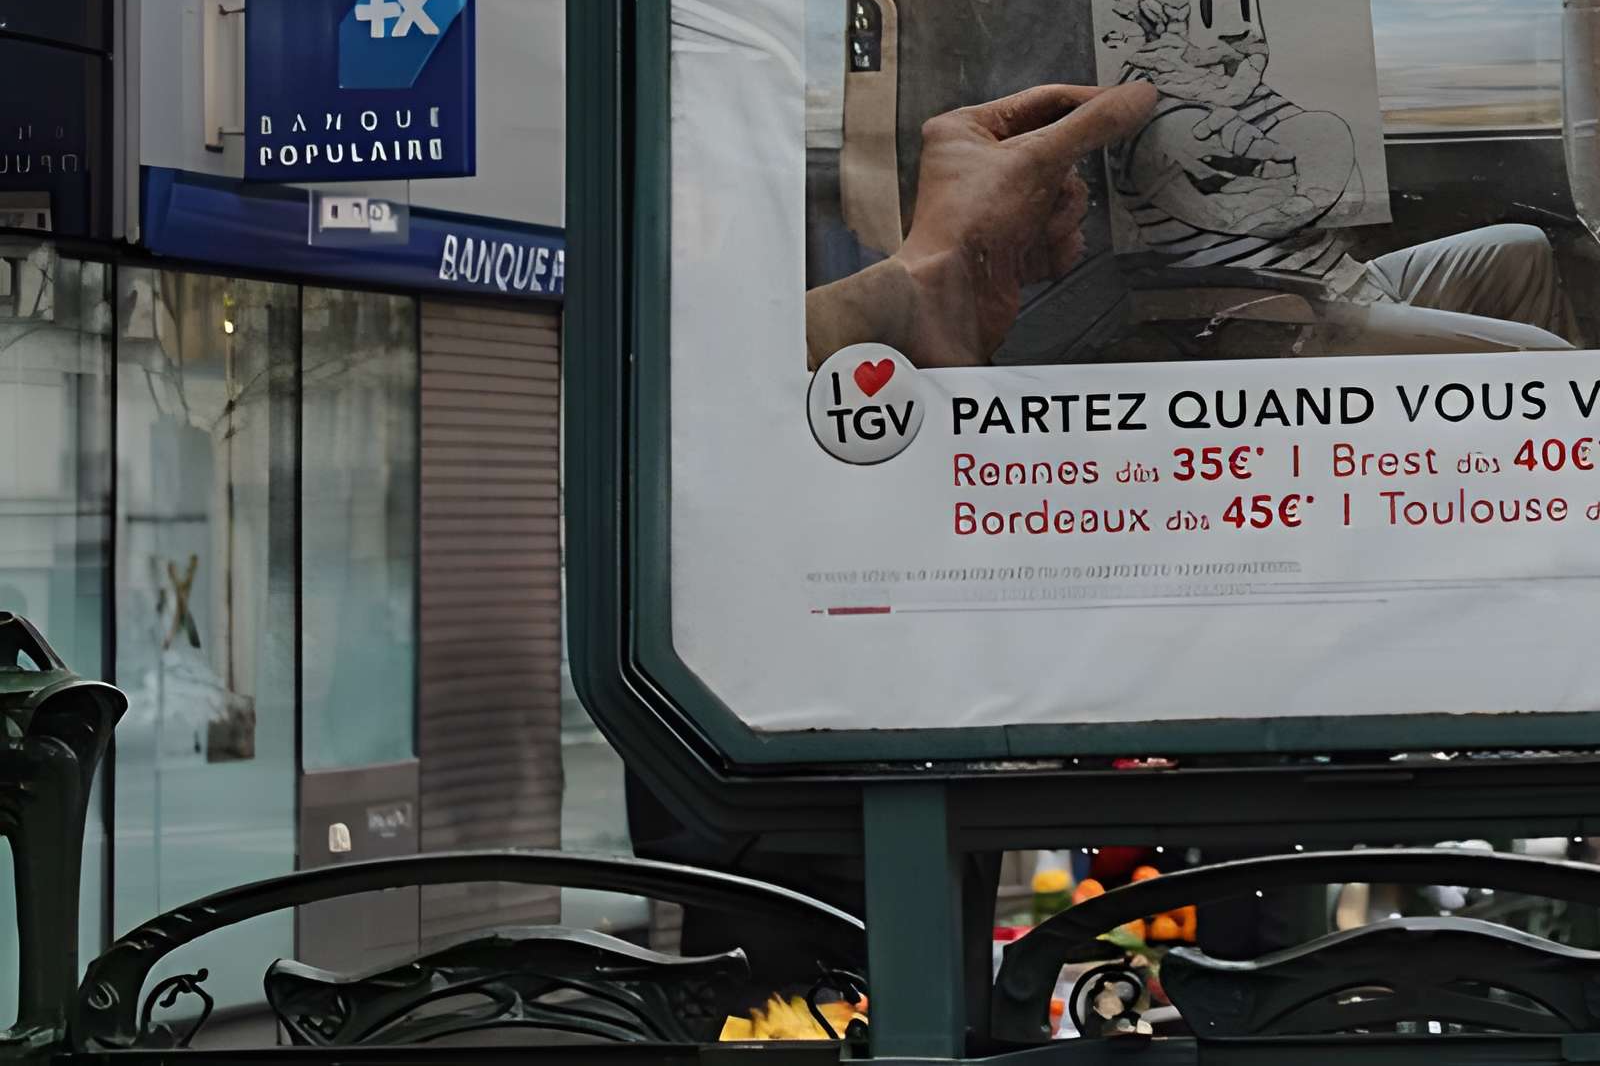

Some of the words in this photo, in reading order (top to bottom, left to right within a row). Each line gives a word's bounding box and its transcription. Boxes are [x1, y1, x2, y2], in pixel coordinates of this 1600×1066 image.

[827, 400, 914, 443] TGV
[952, 392, 1147, 436] PARTEZ
[1167, 385, 1376, 430] QUAND
[1395, 380, 1547, 423] VOUS
[952, 453, 1099, 487] Rennes
[1332, 441, 1439, 478] Brest
[953, 499, 1151, 535] Bordeaux
[1378, 486, 1569, 527] Toulouse
